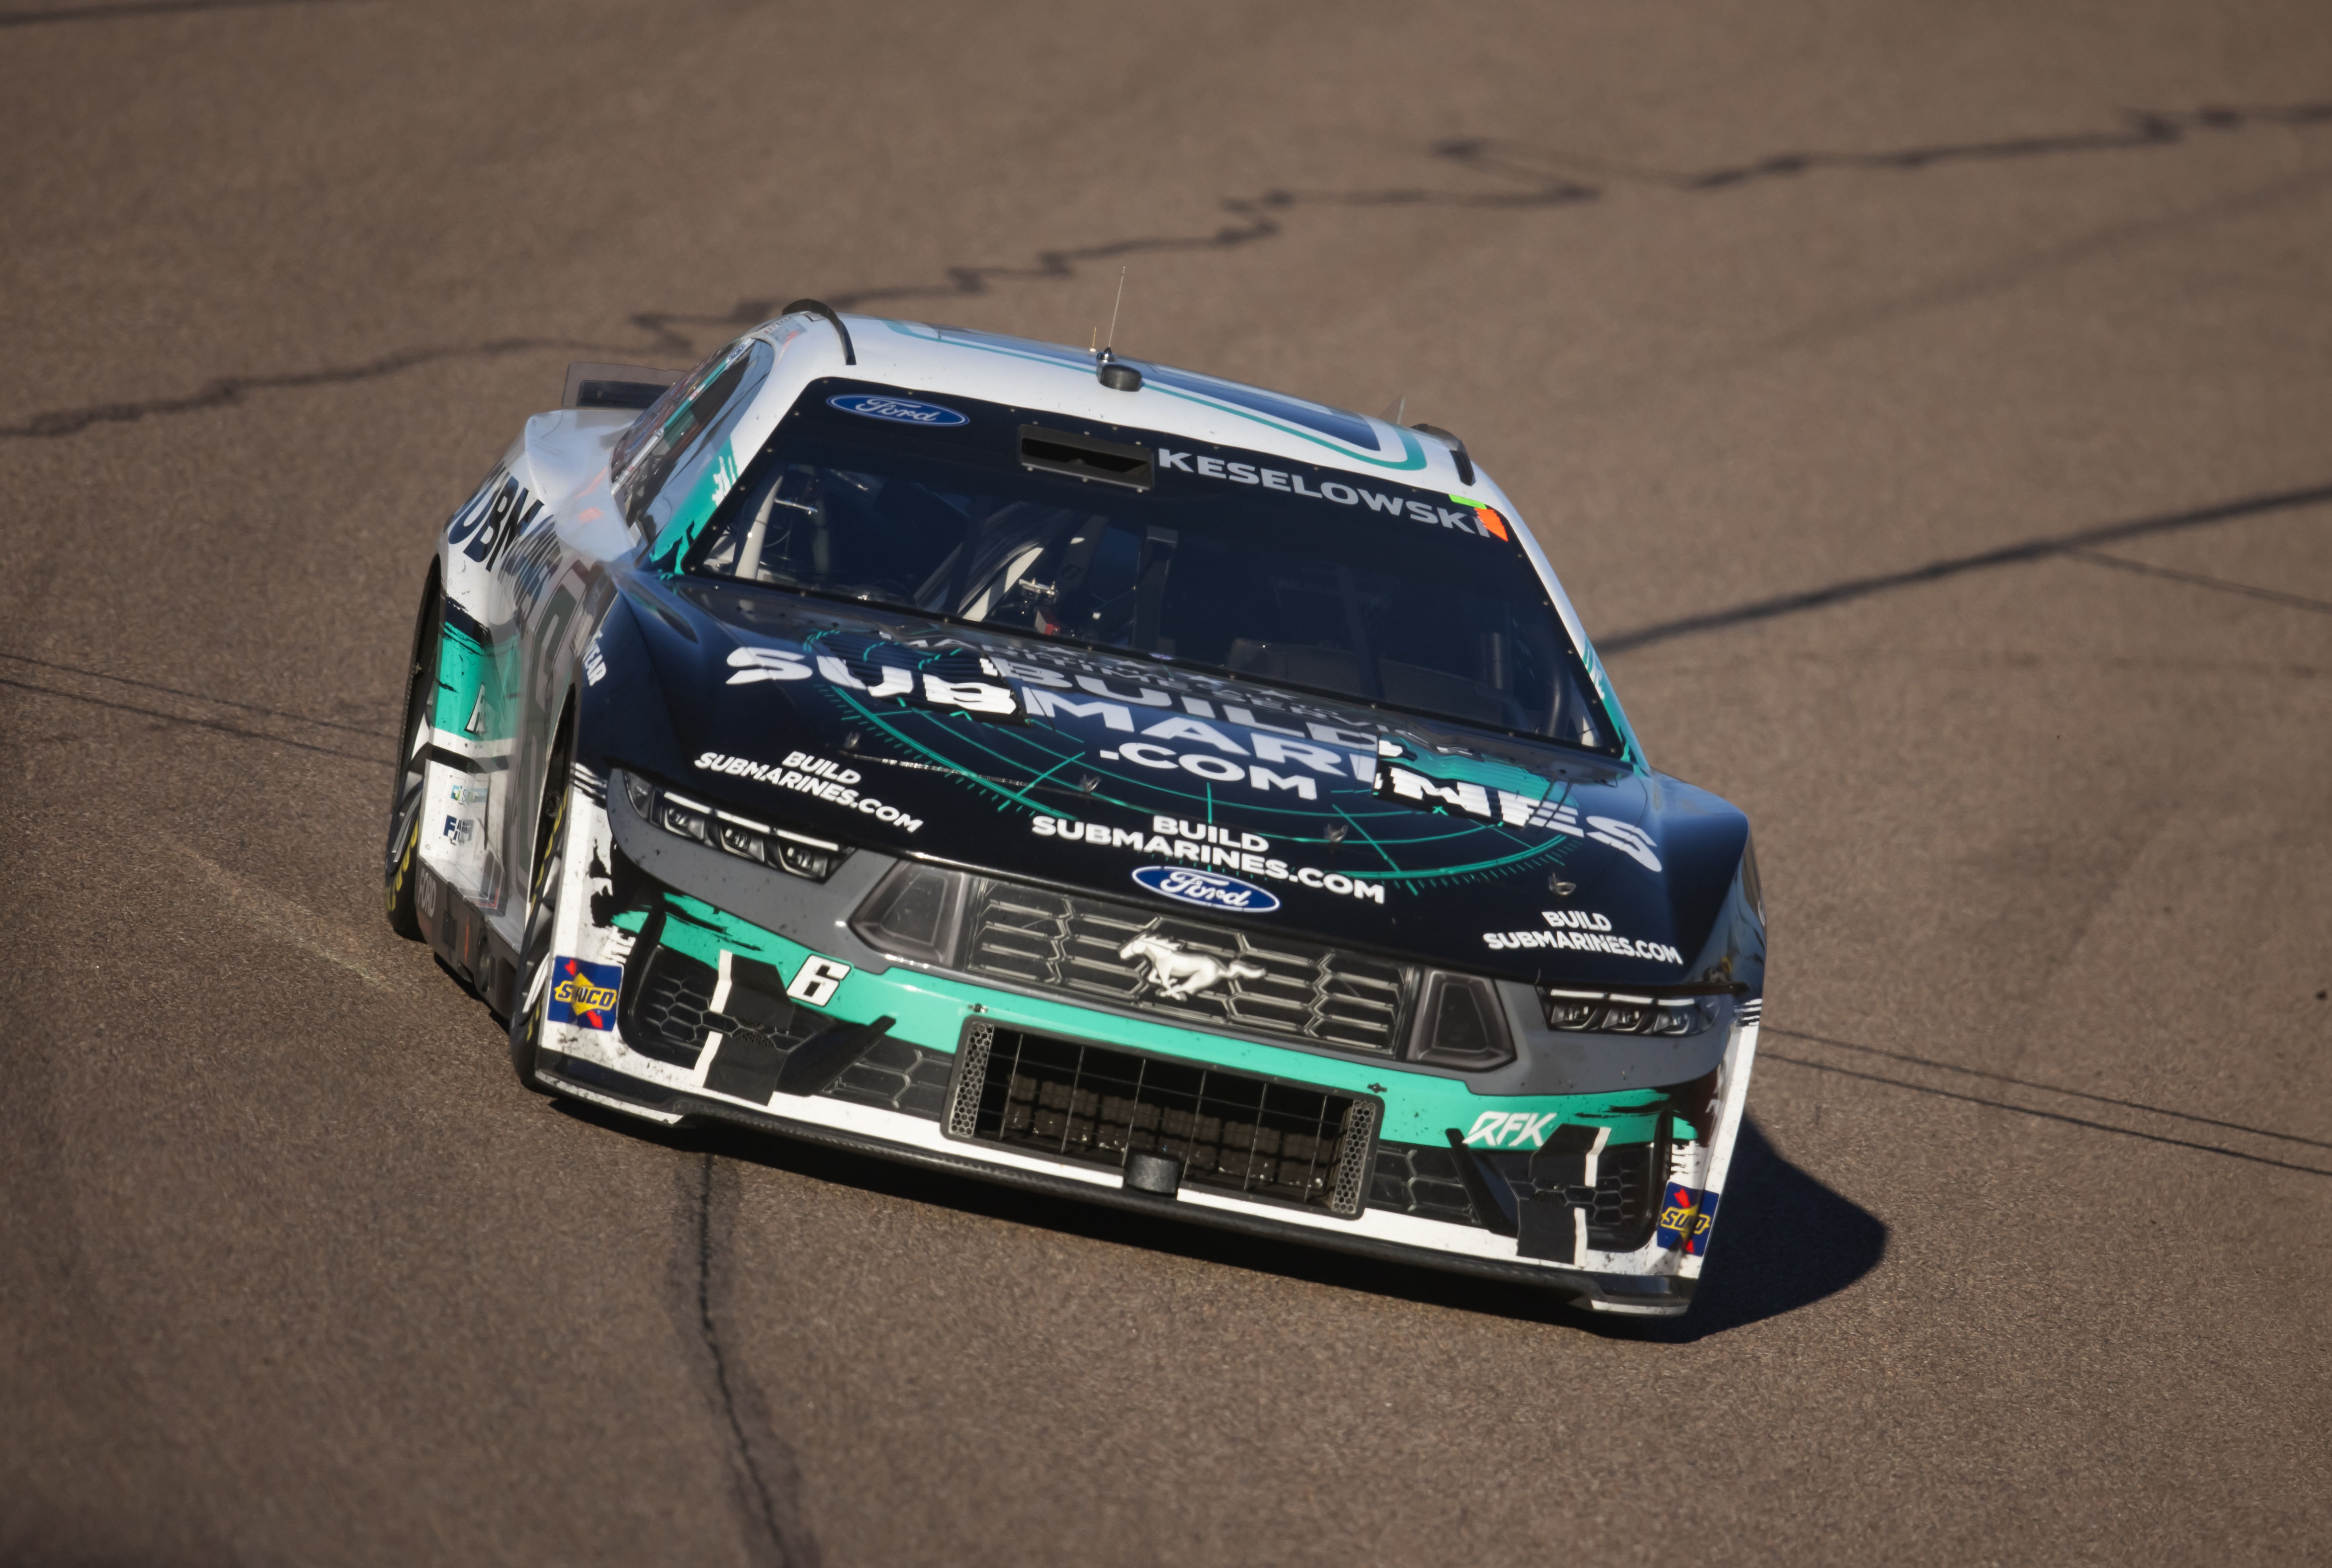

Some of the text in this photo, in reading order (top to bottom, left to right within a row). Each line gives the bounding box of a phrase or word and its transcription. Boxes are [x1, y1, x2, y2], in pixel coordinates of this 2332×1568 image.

[855, 398, 940, 422] Ford
[1159, 448, 1490, 538] KESELOWSKI
[979, 655, 1403, 757] BUILD
[726, 647, 1662, 872] SUBMARINES
[782, 751, 862, 785] BUILD
[1100, 743, 1317, 800] .COM
[694, 752, 924, 833] SUBMARINES.COM
[1153, 815, 1269, 852] BUILD
[1032, 816, 1384, 904] SUBMARINES.COM
[1161, 872, 1251, 906] Ford
[1542, 911, 1612, 932] BUILD
[1483, 931, 1683, 965] SUBMARINES.COM
[558, 984, 614, 1007] SOCO
[786, 954, 851, 1006] 6
[1463, 1110, 1557, 1147] RFK
[1663, 1210, 1707, 1231] SUO
